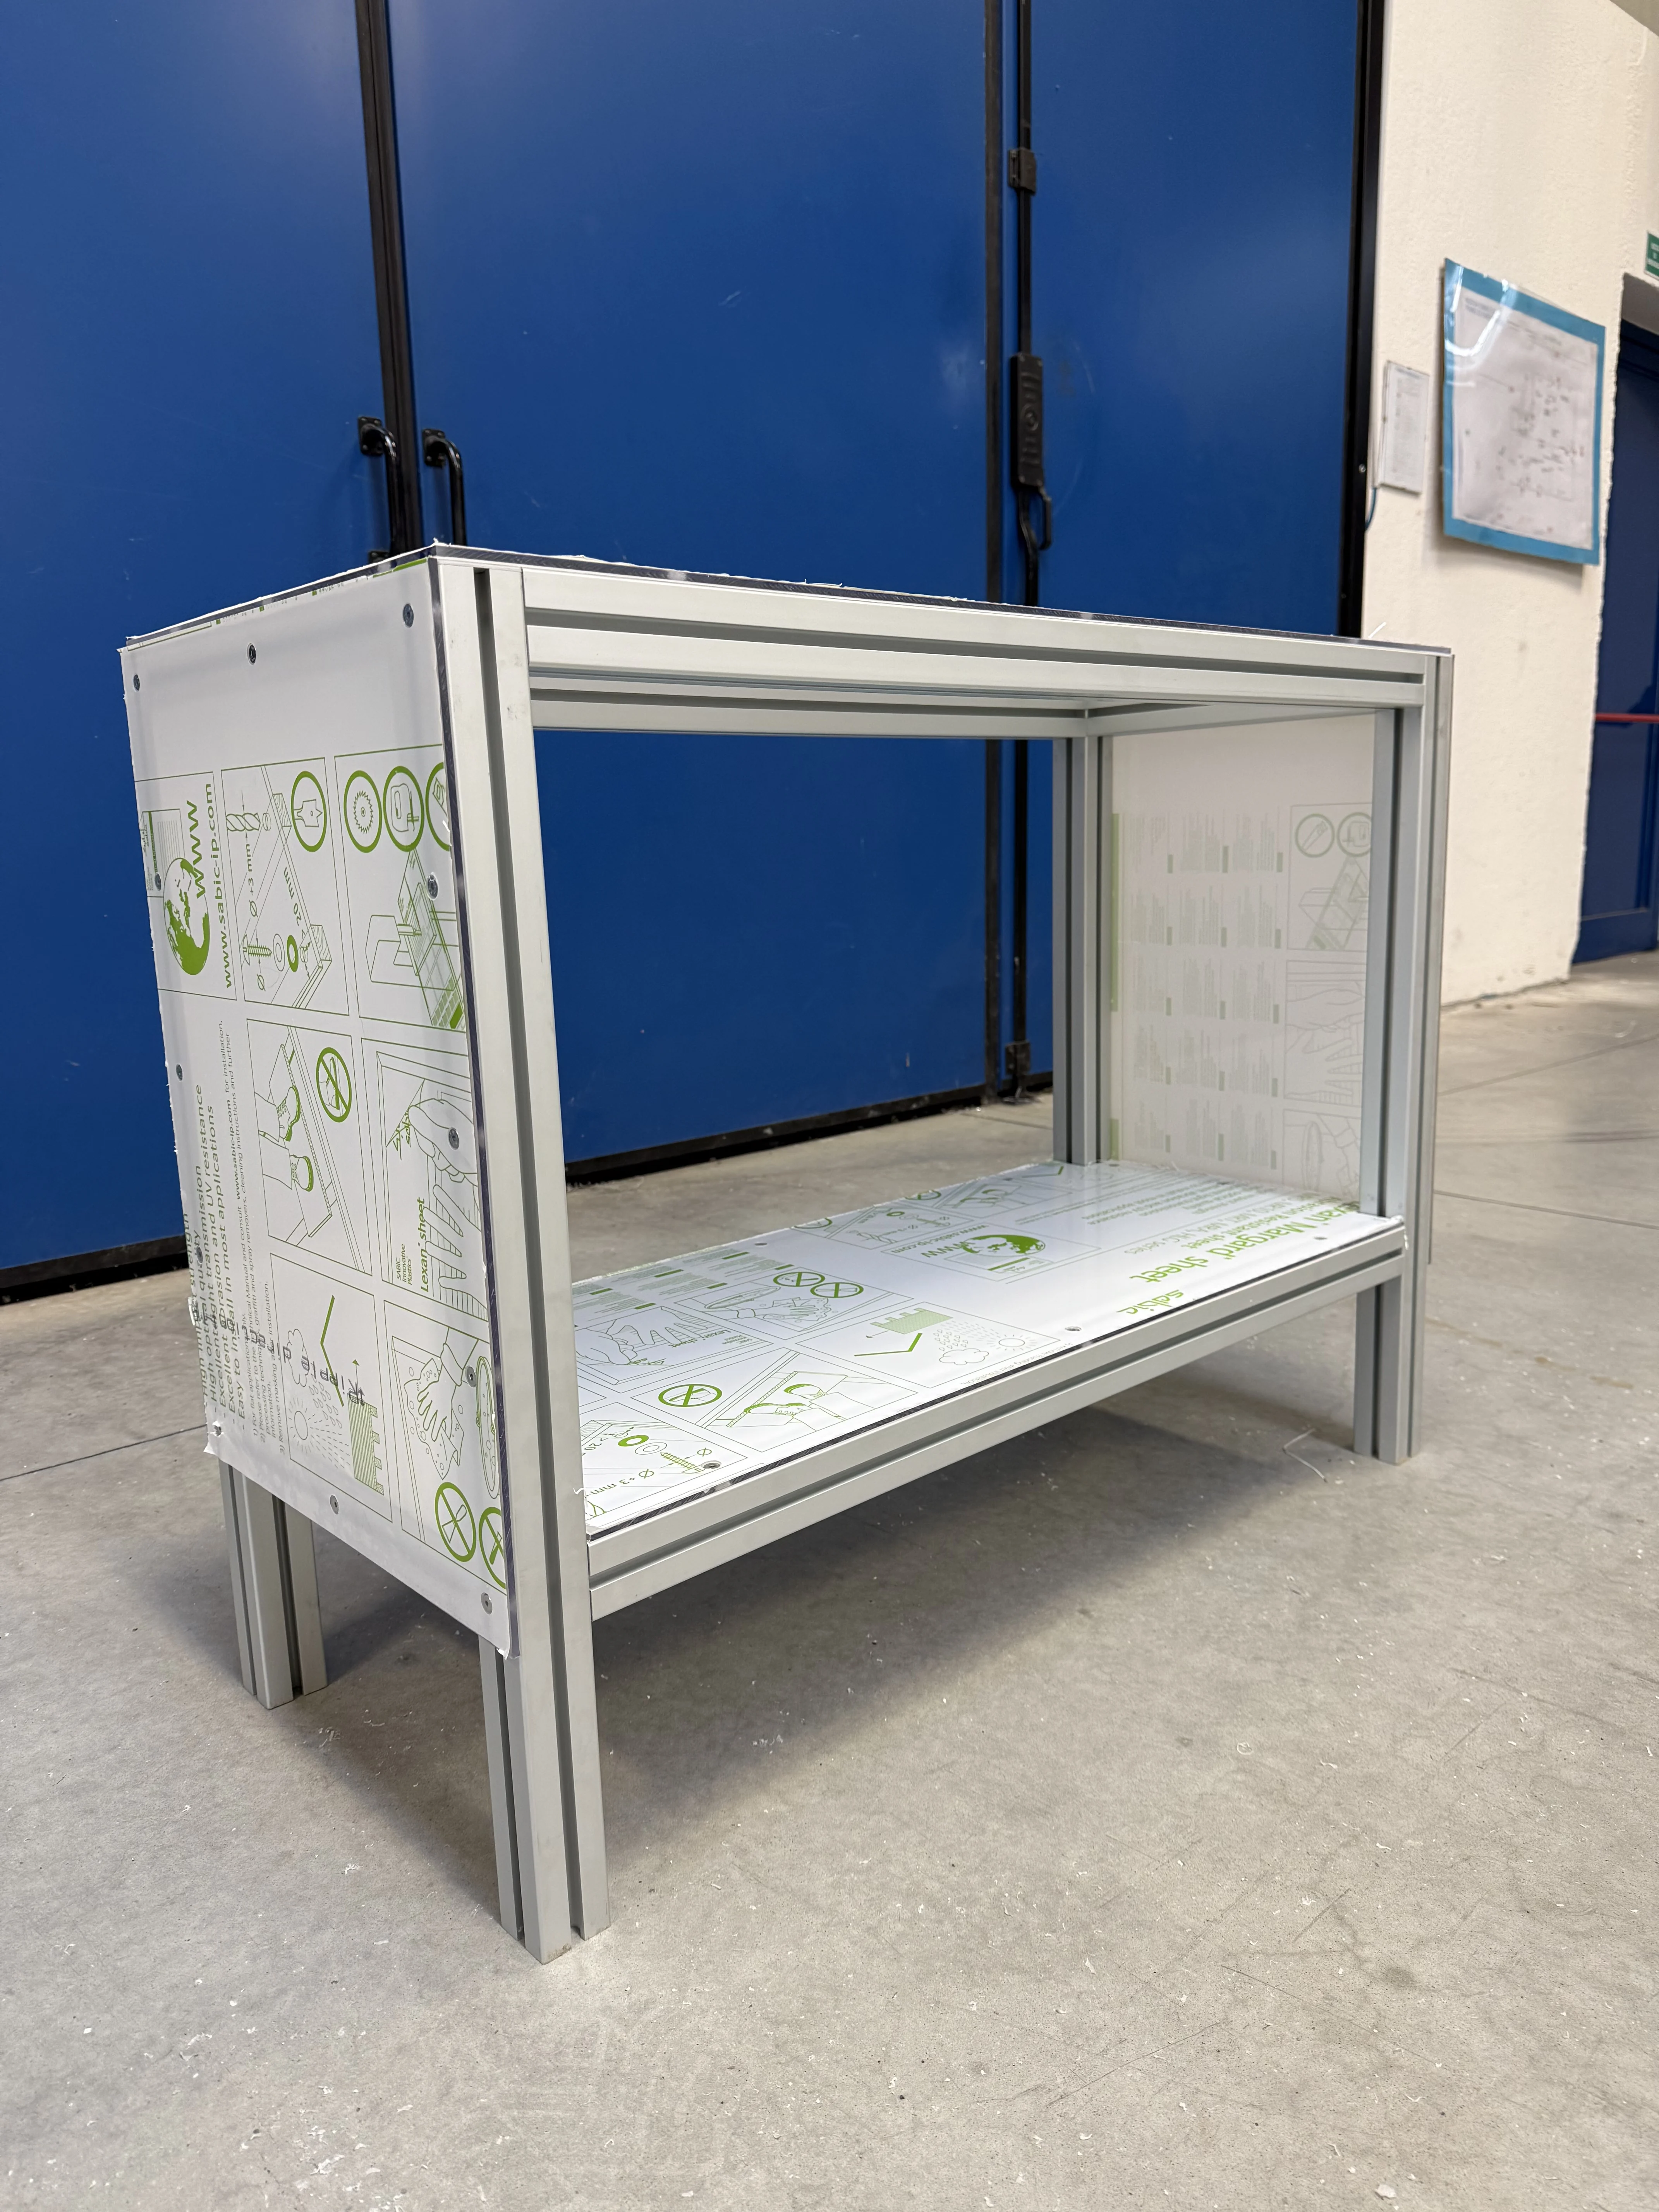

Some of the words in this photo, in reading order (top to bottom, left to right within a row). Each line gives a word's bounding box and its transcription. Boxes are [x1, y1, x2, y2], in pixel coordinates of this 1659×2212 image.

[246, 844, 252, 871] mm
[204, 783, 233, 988] www.sabic-ip.com
[218, 1019, 228, 1077] installation,
[194, 1084, 210, 1176] resistance
[231, 1092, 241, 1149] instructions
[206, 1104, 226, 1220] applications
[225, 1099, 241, 1200] www.sabic-ip.com
[205, 1181, 213, 1207] UV
[237, 1152, 247, 1194] cleaning
[194, 1164, 212, 1278] transmission
[208, 1212, 218, 1247] and
[236, 1205, 244, 1241] consult
[242, 1195, 251, 1243] removers,
[218, 1223, 229, 1270] most
[1206, 1222, 1316, 1259] Margard
[224, 1275, 232, 1292] in
[1129, 1256, 1208, 1283] sheet
[251, 1293, 260, 1326] graffiti
[262, 1279, 273, 1336] installation.
[1117, 1290, 1184, 1316] sabic
[207, 1360, 218, 1403] High
[212, 1327, 225, 1408] Excellent
[221, 1333, 235, 1413] Excellent
[232, 1356, 240, 1376] to
[253, 1364, 258, 1375] to
[271, 1362, 280, 1403] masking
[235, 1380, 246, 1420] Easy
[261, 1383, 271, 1435] processing
[266, 1379, 276, 1439] information.
[275, 1403, 283, 1443] Remove
[590, 1484, 617, 1495] mm
